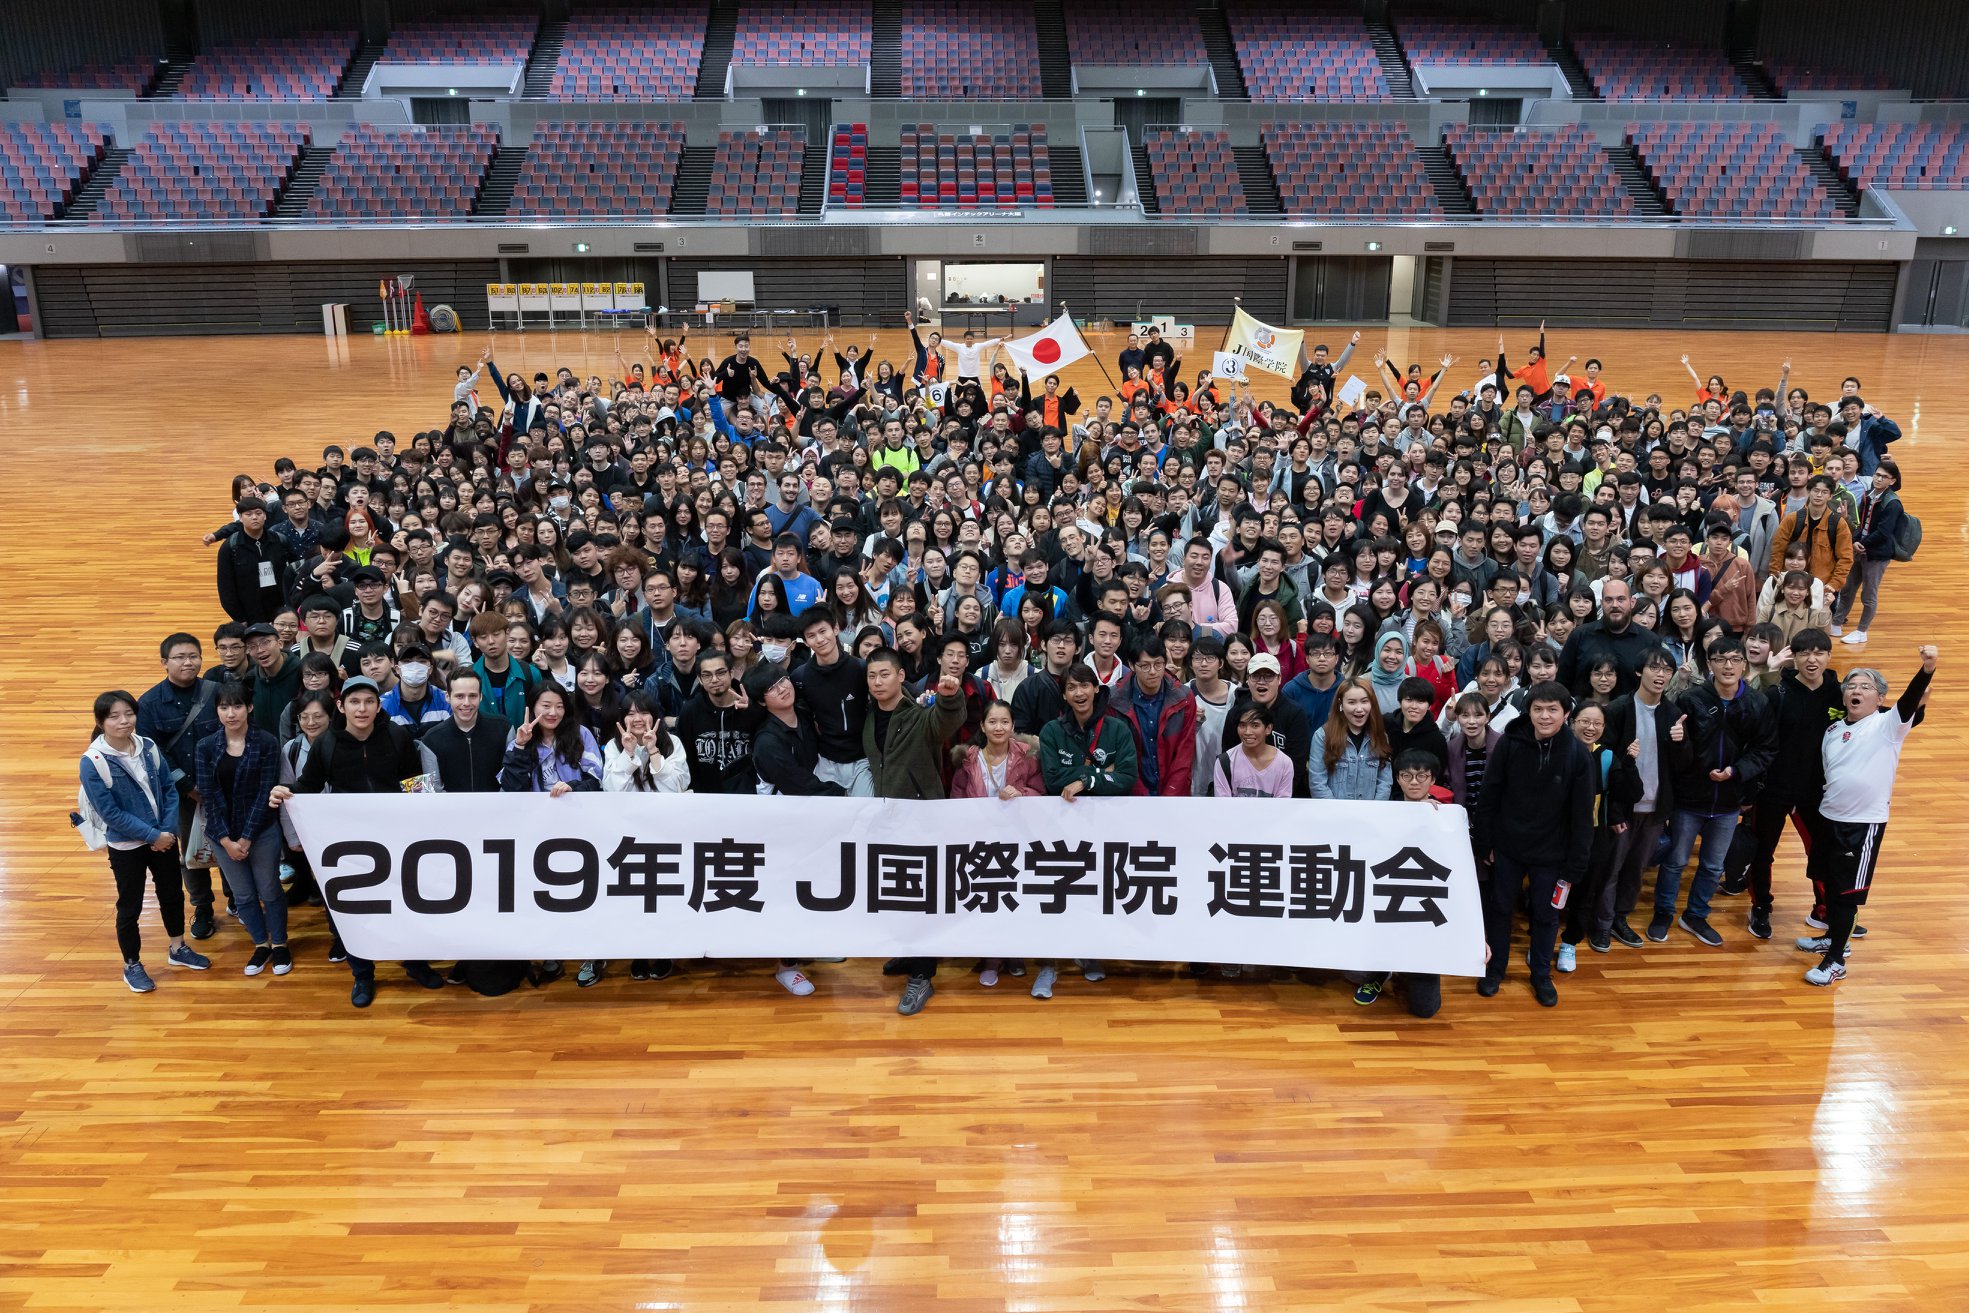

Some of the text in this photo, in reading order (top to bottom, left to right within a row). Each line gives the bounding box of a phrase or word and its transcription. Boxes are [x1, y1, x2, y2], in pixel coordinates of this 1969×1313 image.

[679, 237, 685, 246] 3
[975, 234, 983, 242] 北
[47, 244, 54, 252] 4
[1140, 325, 1148, 336] 2
[1161, 322, 1167, 333] 1
[1180, 327, 1188, 337] 3
[931, 389, 942, 402] 6
[321, 836, 1453, 927] 2019年度 J国際学院 運動会
